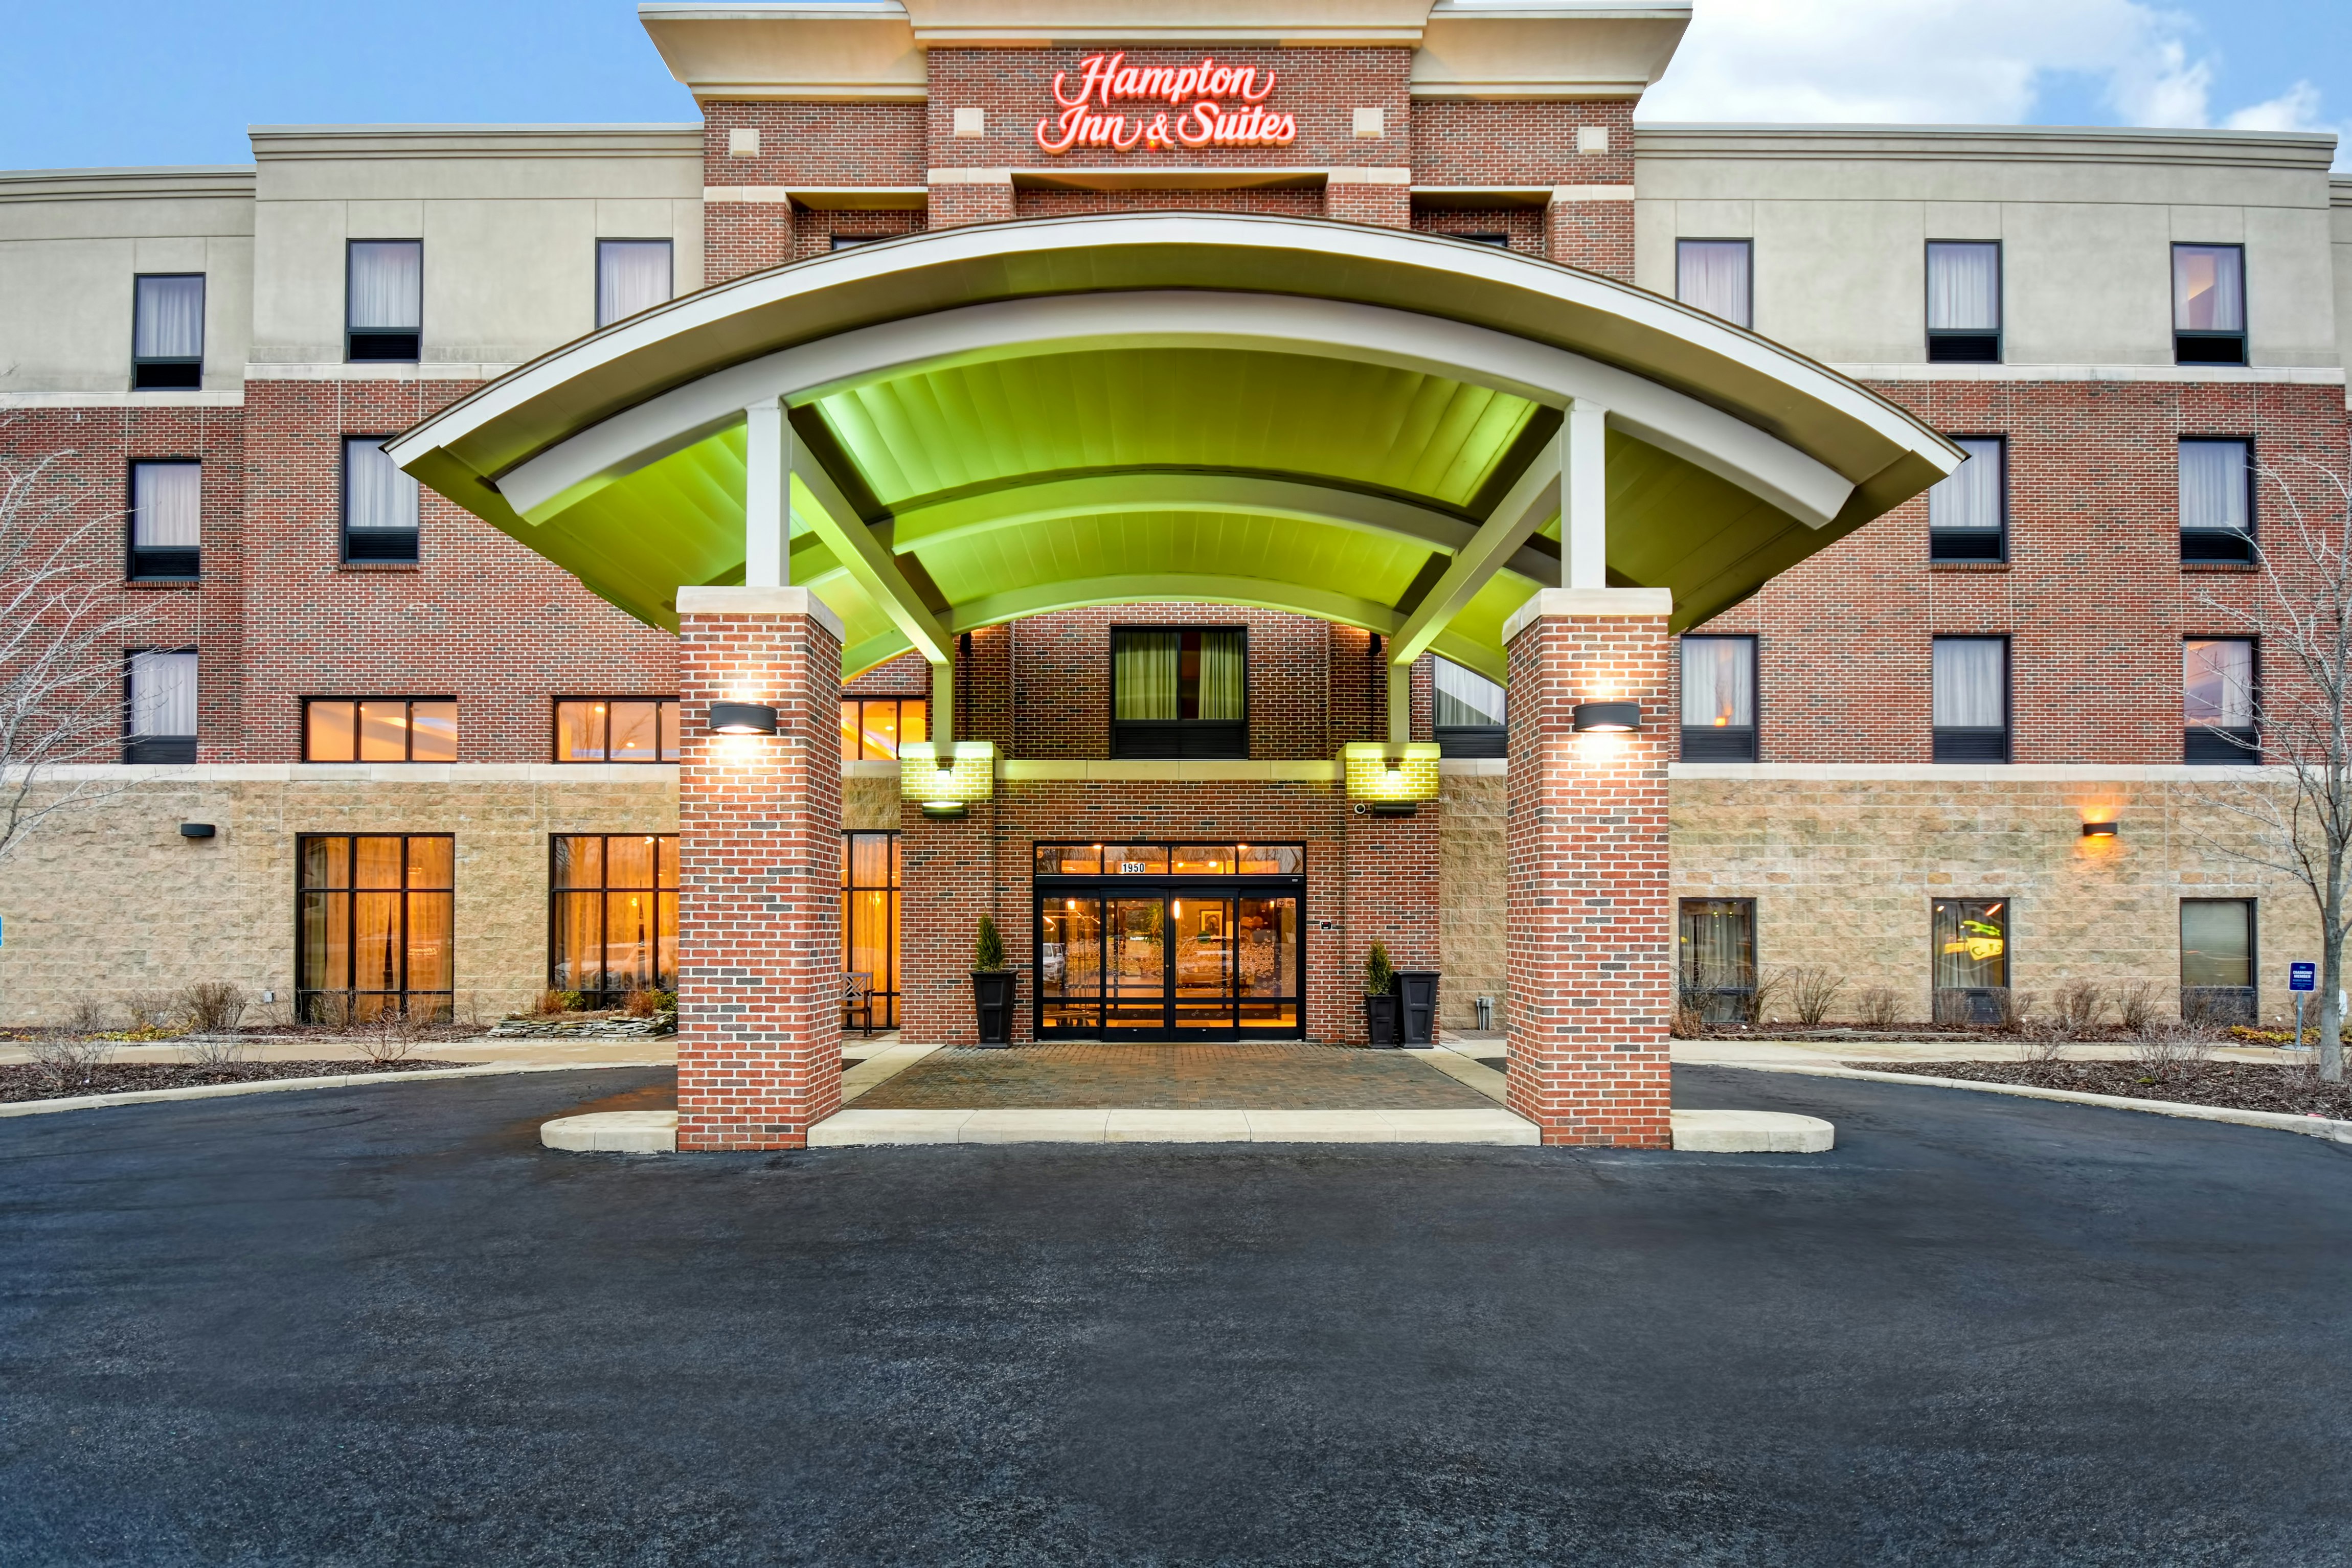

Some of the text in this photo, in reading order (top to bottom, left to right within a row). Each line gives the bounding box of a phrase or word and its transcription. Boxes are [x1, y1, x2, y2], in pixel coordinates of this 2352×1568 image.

[1053, 52, 1275, 108] Hampton
[1036, 100, 1297, 154] Inn & Suites
[1123, 863, 1144, 872] 1950
